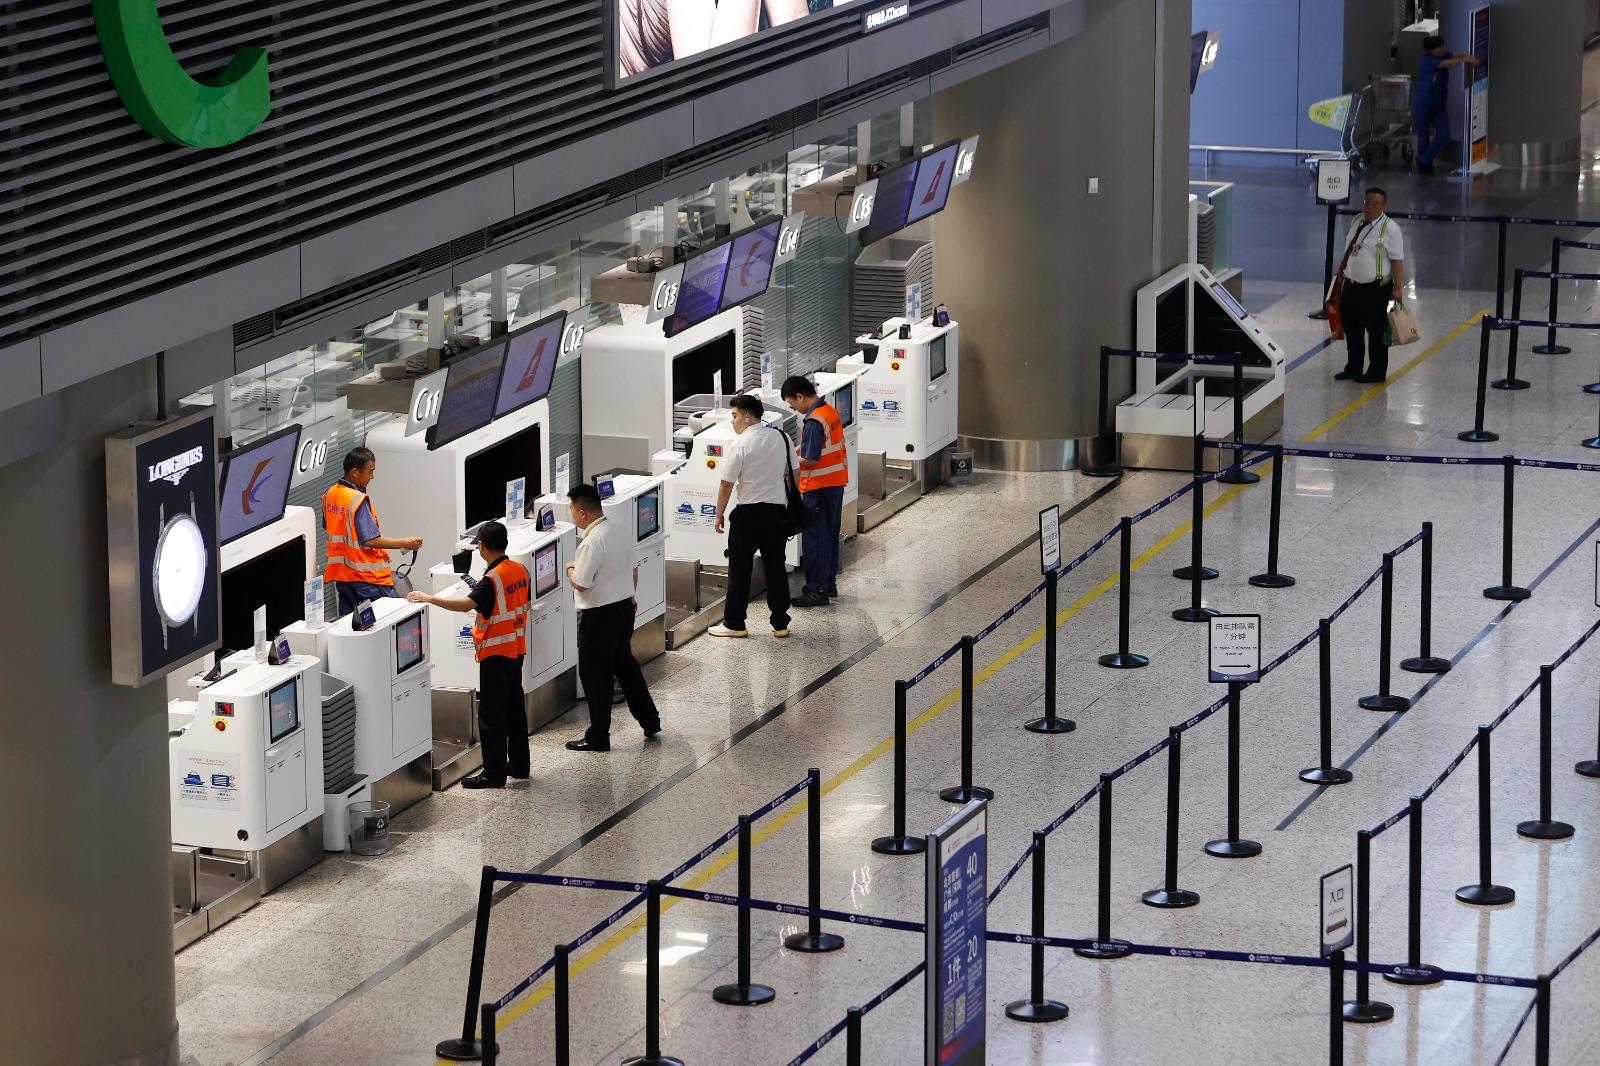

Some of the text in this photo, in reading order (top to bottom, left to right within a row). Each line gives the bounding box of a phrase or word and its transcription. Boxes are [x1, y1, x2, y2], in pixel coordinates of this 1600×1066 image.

[852, 193, 874, 223] C15
[653, 279, 679, 312] C13
[560, 322, 585, 357] C12
[412, 387, 441, 423] C11
[148, 445, 203, 482] LONGINES
[296, 437, 328, 474] C10
[1230, 632, 1246, 641] 分钟
[966, 851, 978, 878] 40
[1329, 887, 1344, 905] 入口
[967, 934, 978, 963] 20
[947, 954, 962, 985] 1件
